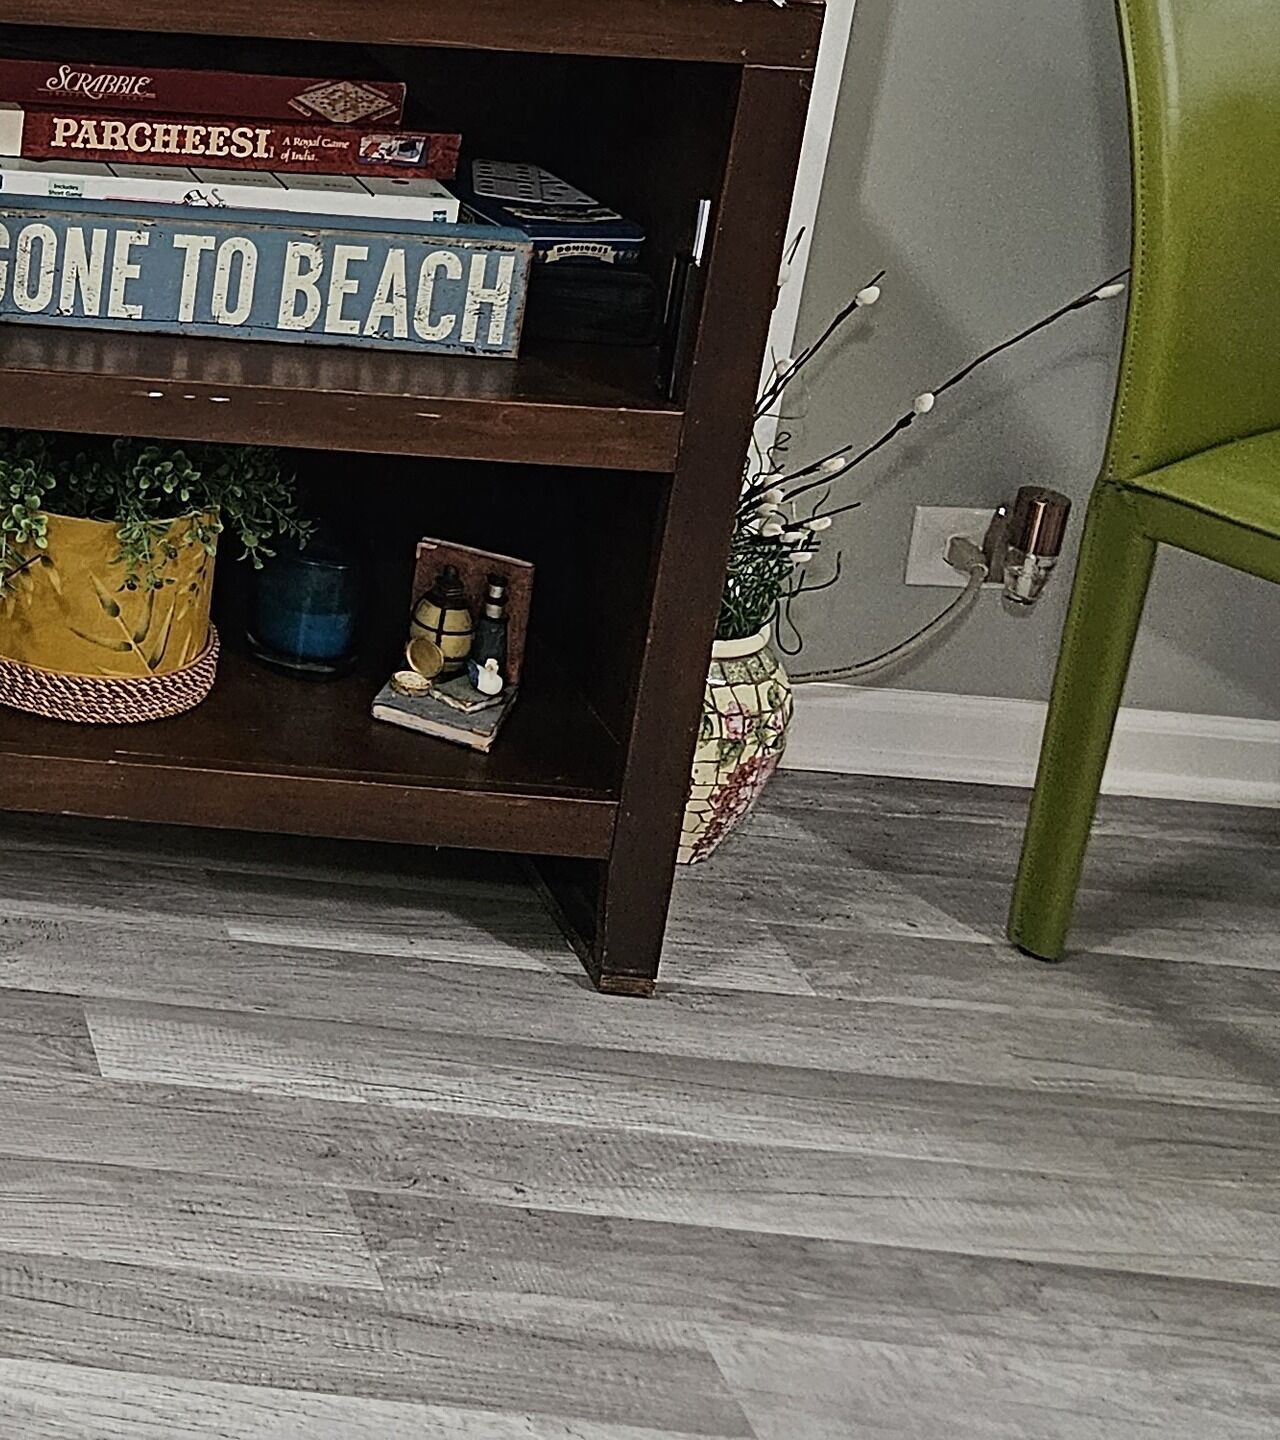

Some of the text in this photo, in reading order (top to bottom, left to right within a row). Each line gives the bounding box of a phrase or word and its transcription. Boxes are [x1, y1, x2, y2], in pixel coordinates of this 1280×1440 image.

[46, 64, 151, 100] SCRABBLE
[50, 117, 272, 158] PARCHEESI
[281, 136, 351, 150] A Royal Game
[280, 150, 291, 162] of
[53, 182, 80, 191] Includes
[172, 232, 258, 326] TO
[277, 240, 516, 345] BEACH
